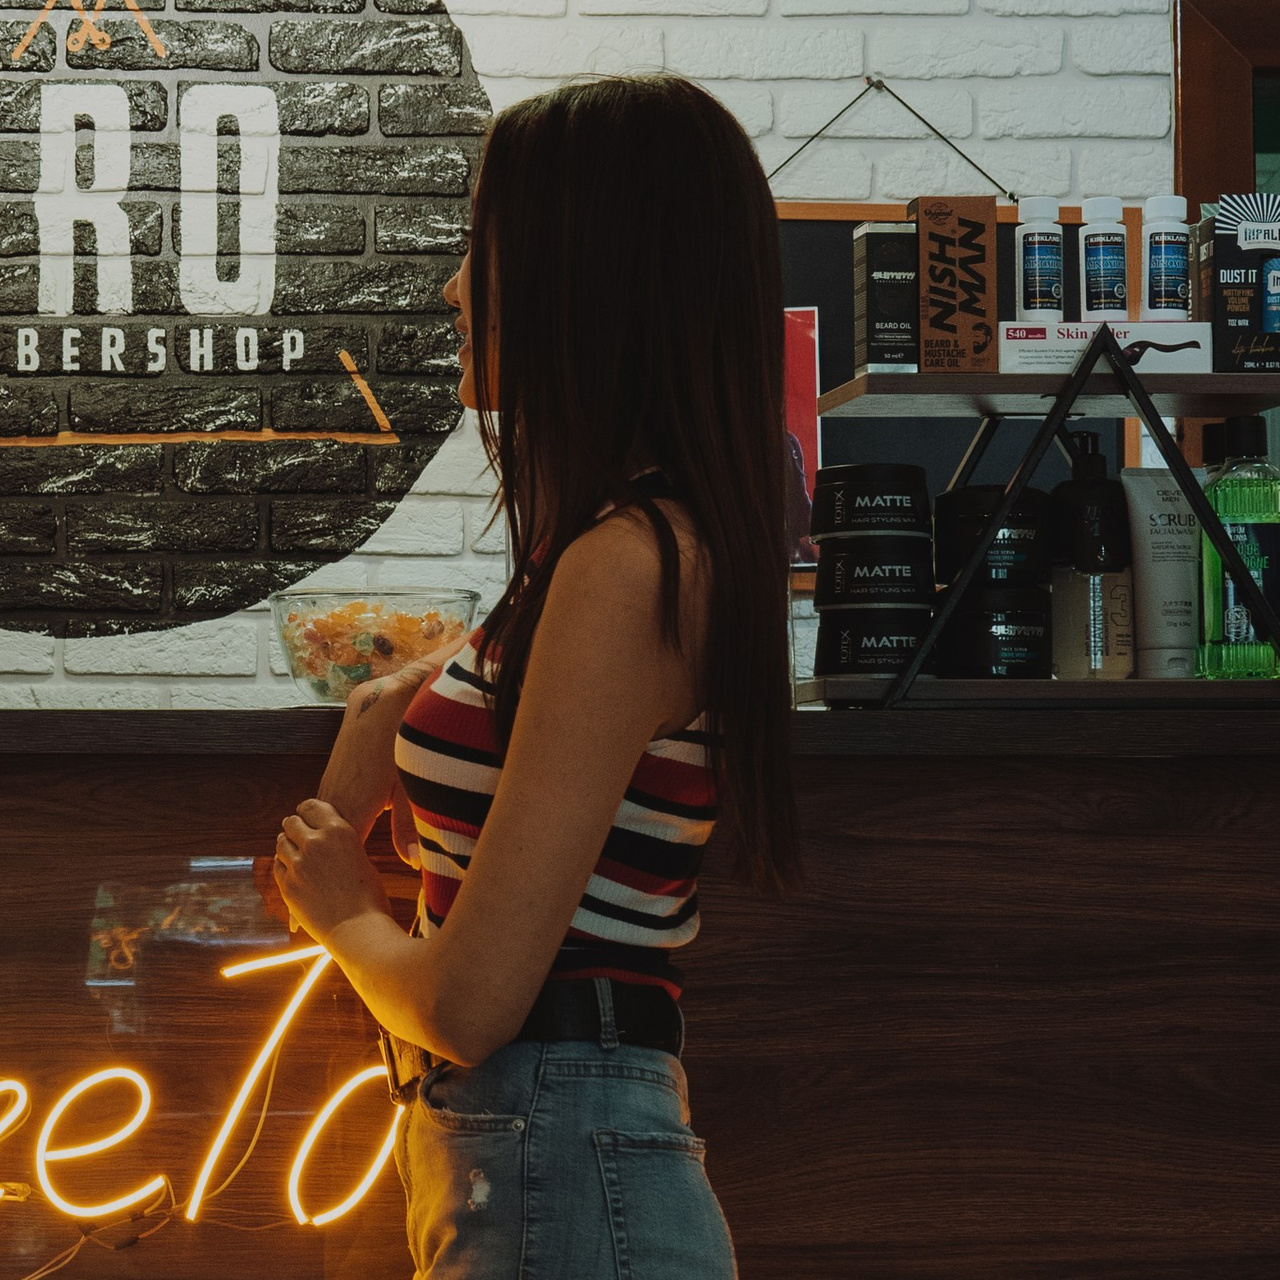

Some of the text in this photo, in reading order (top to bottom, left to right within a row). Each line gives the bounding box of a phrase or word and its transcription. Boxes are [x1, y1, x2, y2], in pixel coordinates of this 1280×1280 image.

[1089, 235, 1122, 243] KIRKLAND
[958, 216, 986, 318] MAN
[1220, 269, 1246, 283] DUST
[1248, 269, 1257, 283] IT
[928, 232, 957, 334] NISH
[1227, 304, 1250, 312] POWDER
[1007, 329, 1026, 339] 540
[1057, 327, 1088, 340] Skin
[924, 339, 951, 348] BEARD
[953, 339, 959, 348] &
[924, 349, 966, 358] MUSTACHE
[924, 358, 946, 368] CARE
[947, 358, 960, 368] OIL
[855, 495, 912, 507] MATTE
[1149, 513, 1196, 527] SCRUB
[854, 565, 912, 578] MATTE
[861, 635, 917, 648] MATTE
[186, 943, 407, 1227] To
